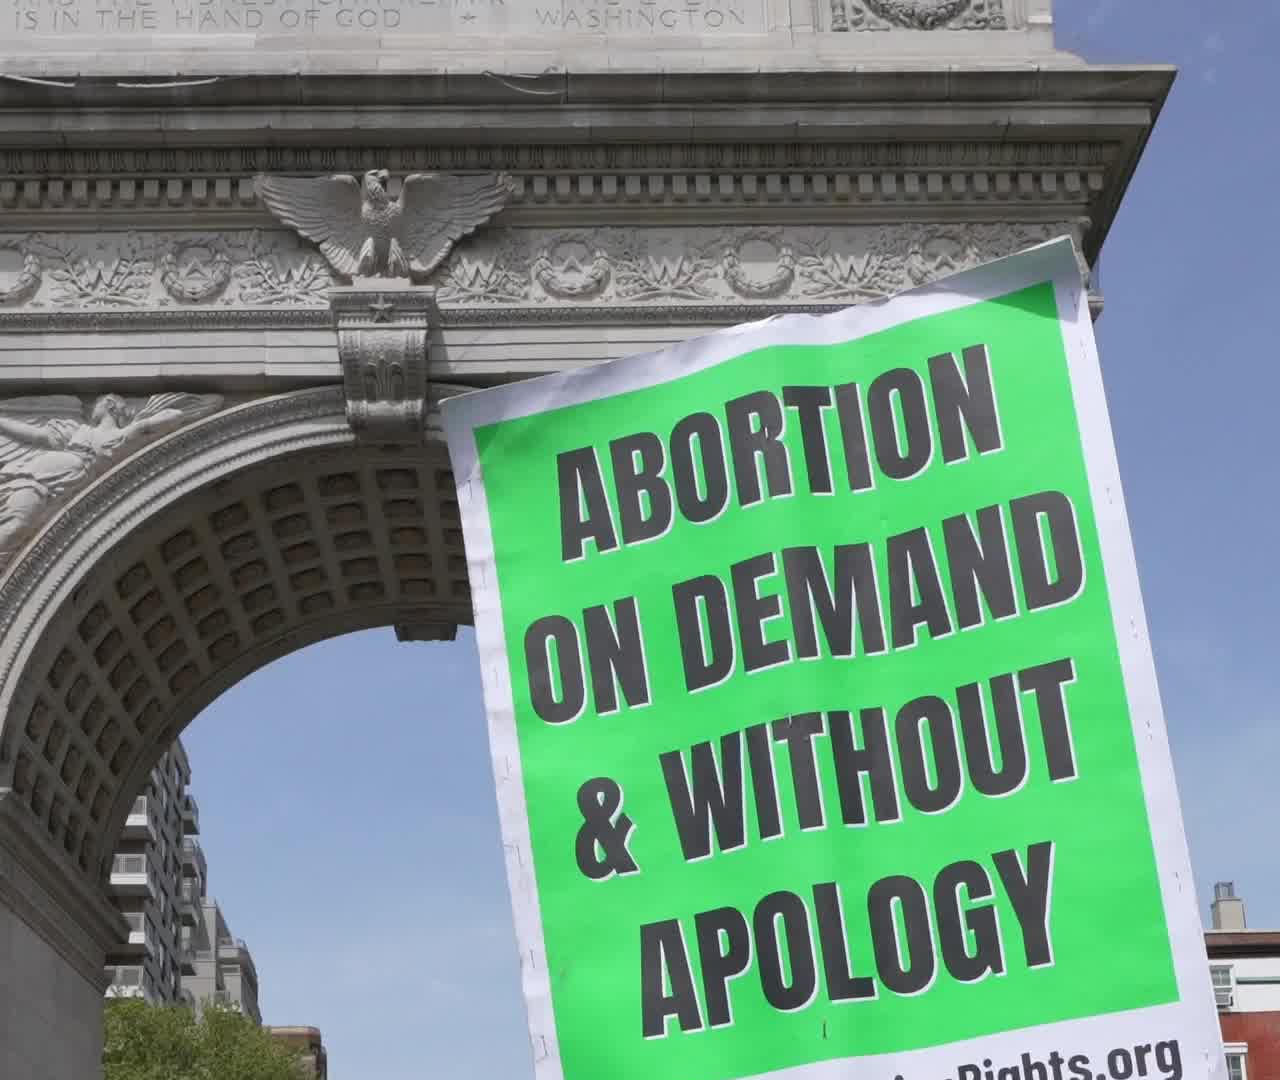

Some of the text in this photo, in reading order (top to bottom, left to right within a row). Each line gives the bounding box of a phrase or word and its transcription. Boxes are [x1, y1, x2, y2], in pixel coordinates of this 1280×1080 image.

[14, 8, 401, 31] IS IN THE HAND OF GOD
[535, 8, 745, 28] WASHINGTON
[557, 342, 1002, 561] ABORTION
[524, 491, 1083, 723] ON DEMAND
[575, 658, 1075, 879] & WITHOUT
[639, 841, 1053, 1037] APOLOGY
